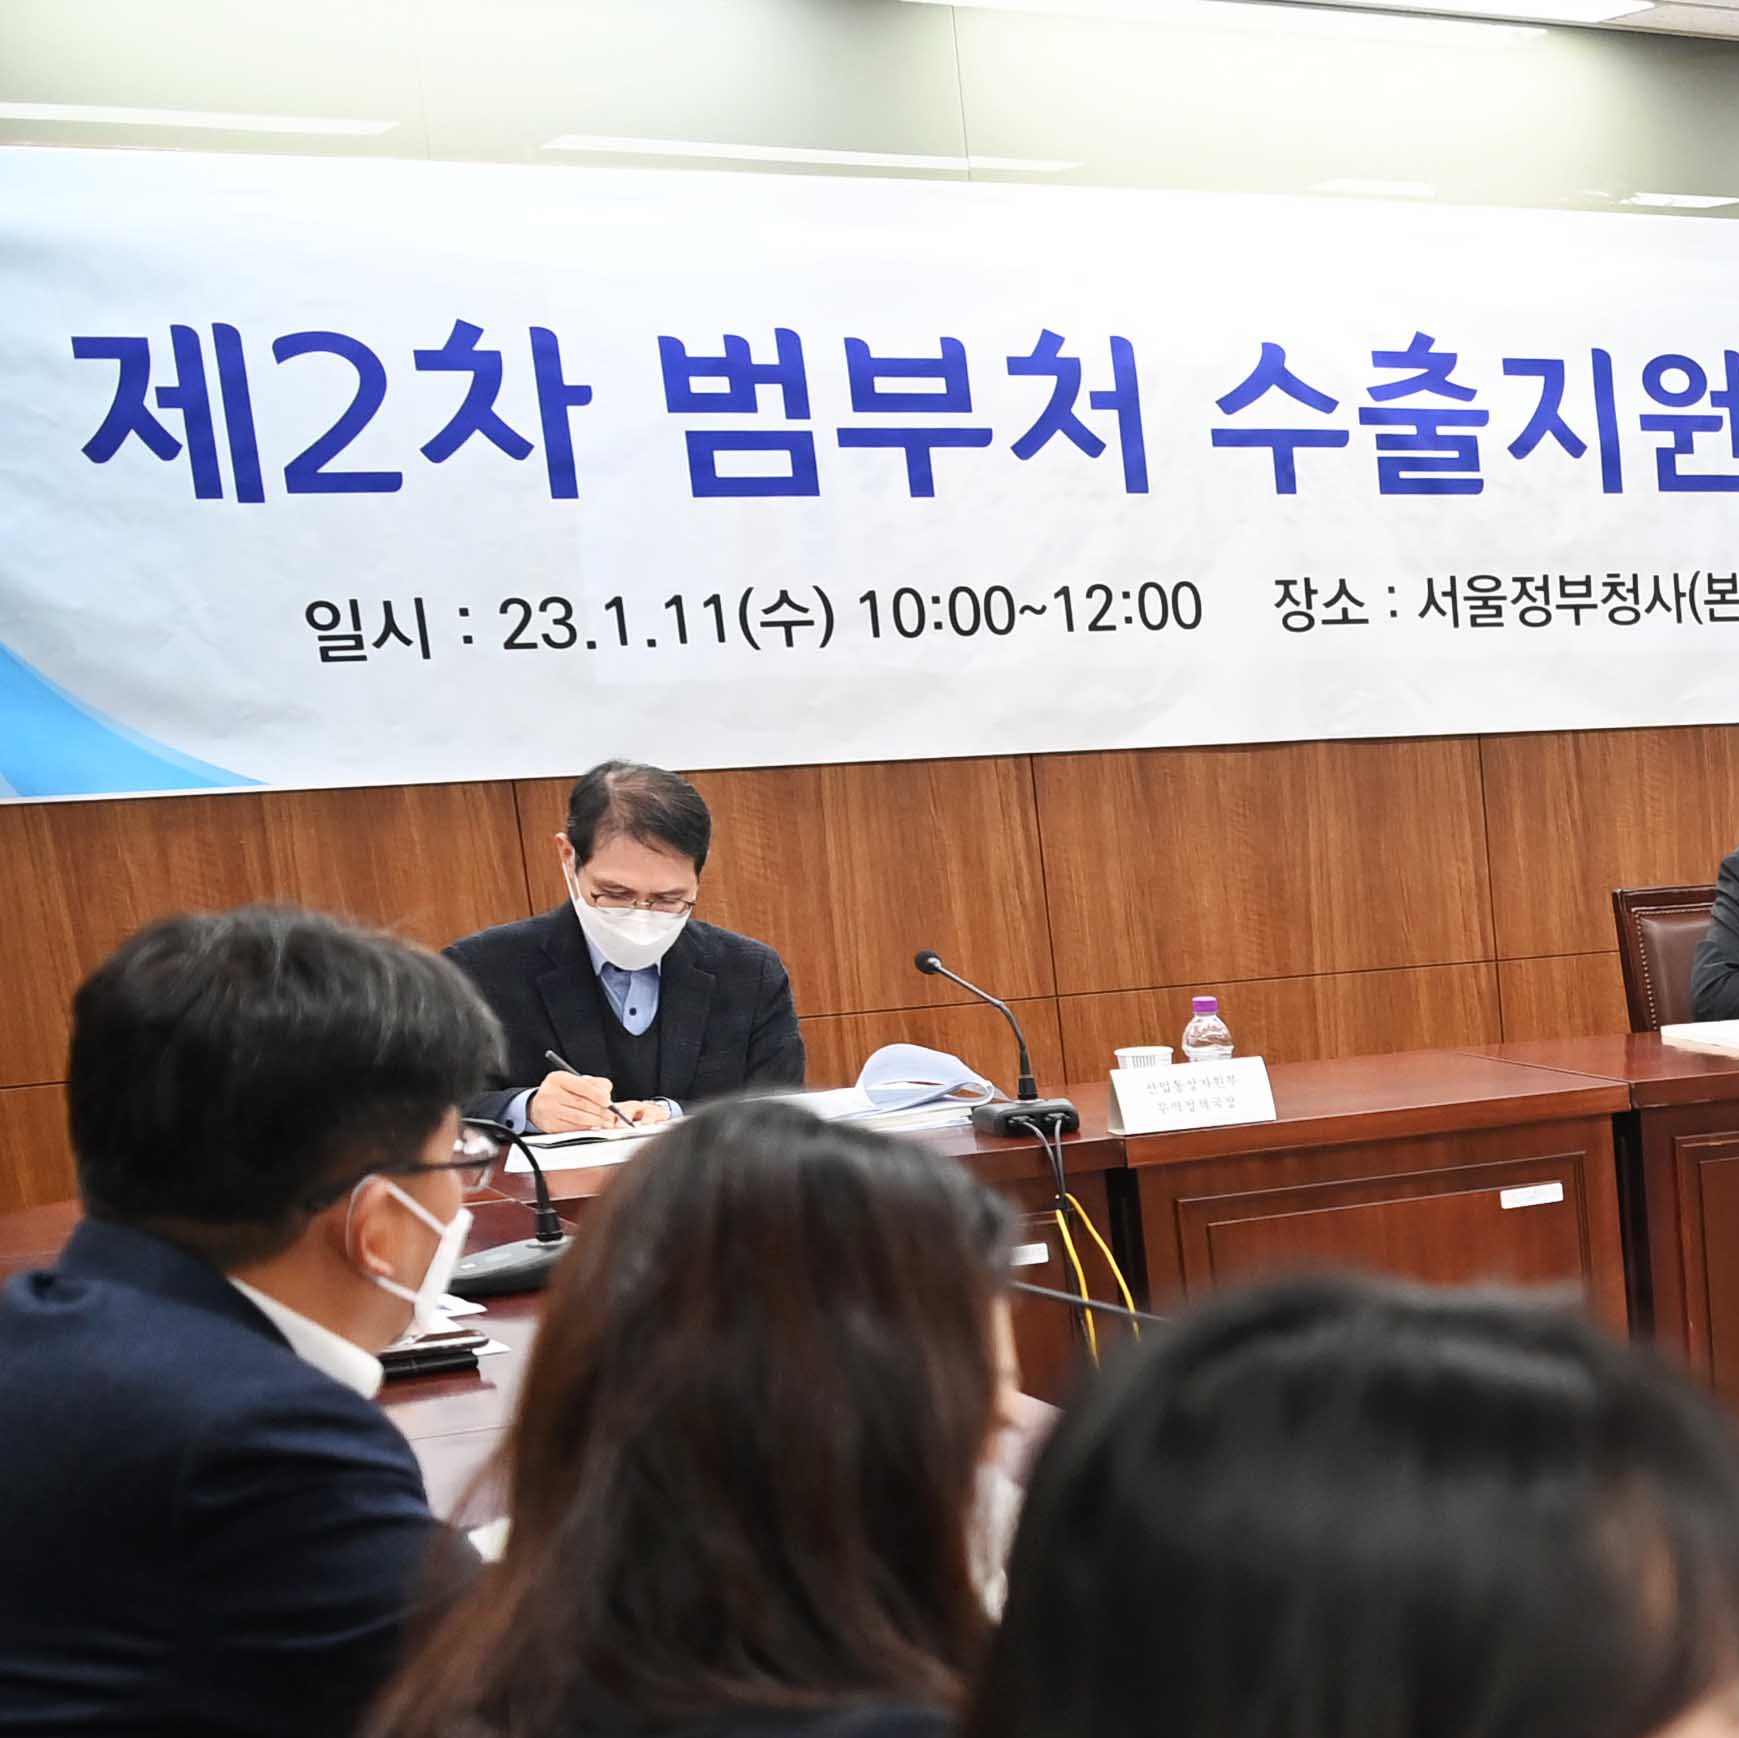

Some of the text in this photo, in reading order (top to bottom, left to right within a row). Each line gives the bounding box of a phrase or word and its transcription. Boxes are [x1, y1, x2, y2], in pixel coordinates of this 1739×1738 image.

[72, 319, 594, 505] 제2차
[658, 328, 1151, 499] 범부처
[306, 598, 432, 664] 일시
[459, 608, 474, 646] :
[500, 584, 836, 653] 23.1.11(수)
[860, 580, 1204, 640] 10:00~12:00
[1274, 576, 1370, 634] 장소
[1388, 586, 1399, 620] :
